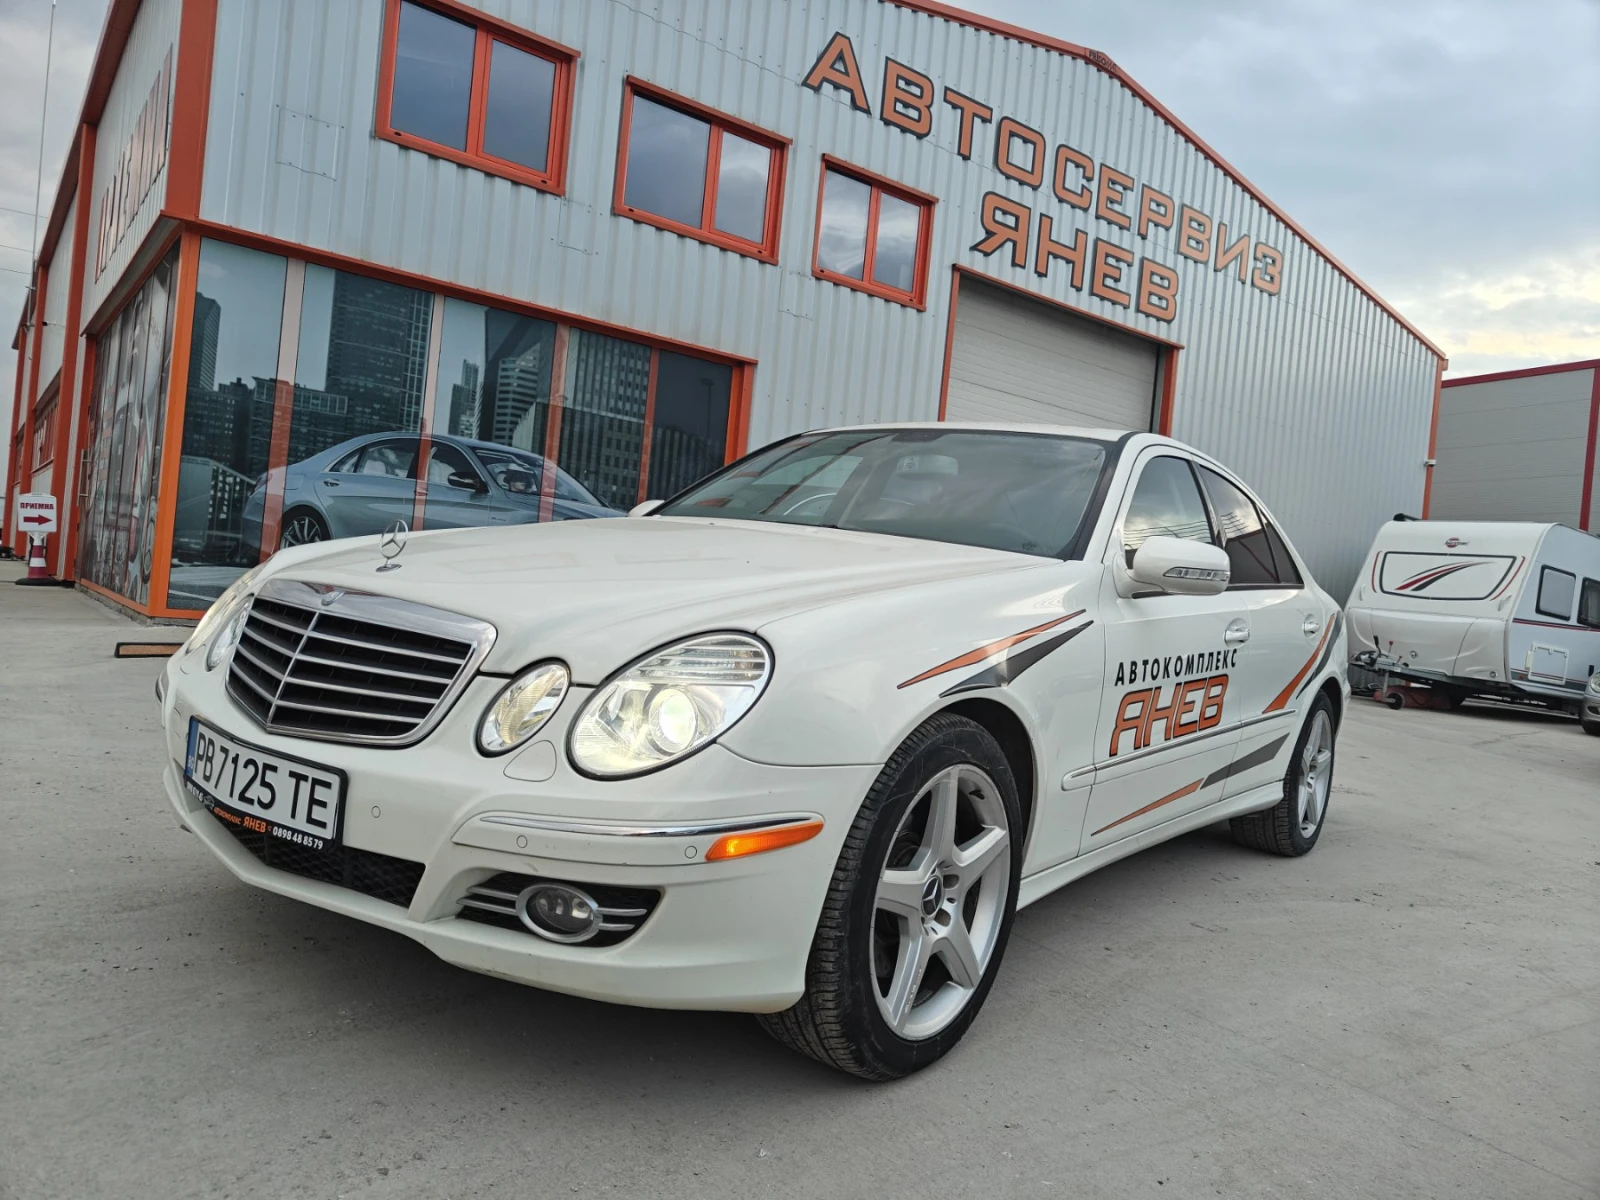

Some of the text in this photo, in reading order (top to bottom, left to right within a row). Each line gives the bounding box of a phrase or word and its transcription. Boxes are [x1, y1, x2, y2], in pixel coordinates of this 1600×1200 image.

[802, 31, 1283, 295] АВТОСЕРВИЗ
[970, 191, 1180, 323] ЯНЕВ
[20, 502, 54, 510] ПРИЕМНА
[1114, 648, 1237, 686] АВТОКОМПЛЕКС
[1109, 673, 1229, 757] ЯНЕВ
[243, 816, 267, 832] ЯНЕВ
